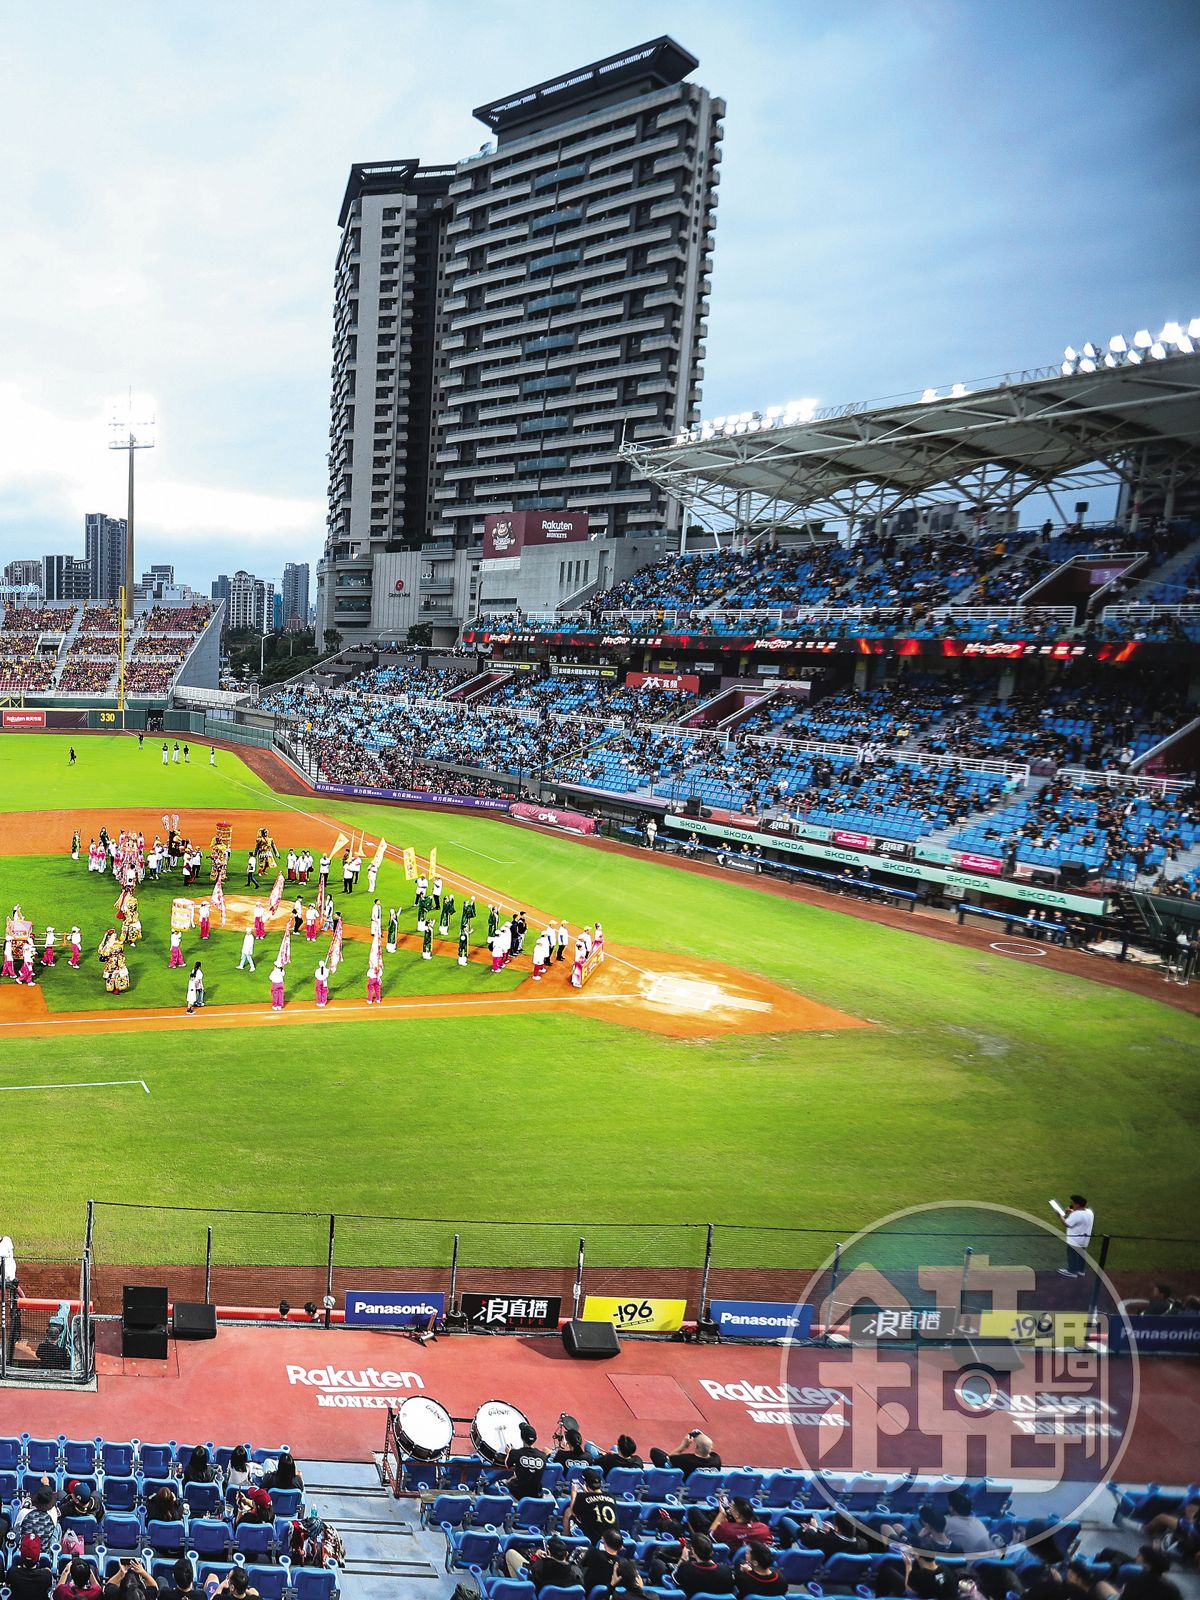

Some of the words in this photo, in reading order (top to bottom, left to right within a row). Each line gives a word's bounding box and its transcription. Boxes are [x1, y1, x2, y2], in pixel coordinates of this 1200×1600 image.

[541, 520, 573, 530] Rakuten
[100, 713, 115, 722] 330
[354, 1301, 434, 1315] Panasonic
[720, 1312, 800, 1328] Panasonic
[1120, 1327, 1200, 1340] Panasonic
[285, 1364, 426, 1389] Rakuten
[699, 1379, 854, 1406] Rakuten
[746, 1410, 851, 1427] MONKEYS
[593, 1505, 616, 1524] 10
